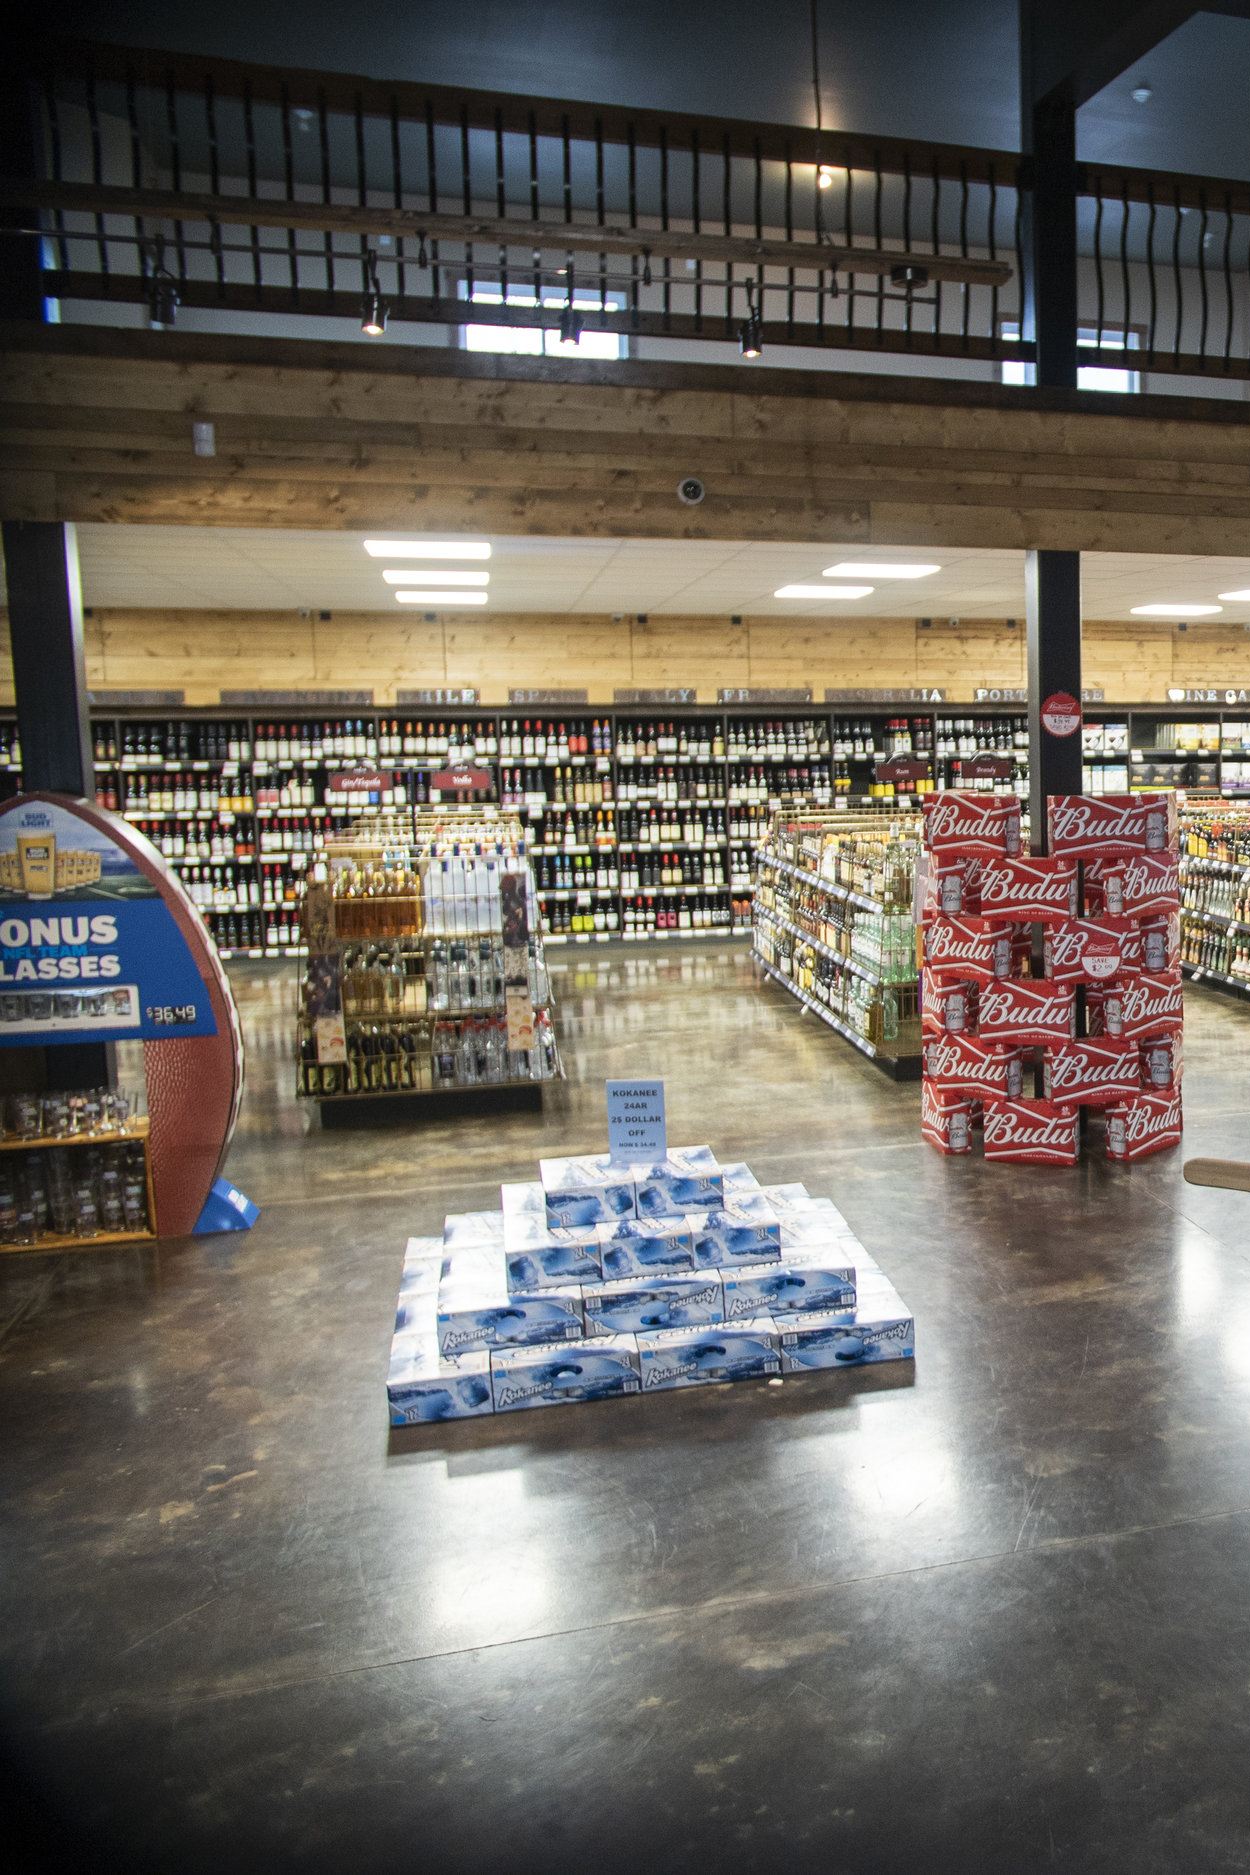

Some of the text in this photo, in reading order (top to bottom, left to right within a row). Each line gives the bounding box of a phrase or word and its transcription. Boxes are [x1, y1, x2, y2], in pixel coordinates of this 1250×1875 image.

[976, 689, 1027, 703] PORT
[21, 819, 51, 828] LIGHT
[3, 944, 88, 959] NFL TEAM
[612, 1089, 658, 1097] KOKANEE
[624, 1102, 648, 1110] 24AR
[628, 1129, 646, 1137] OFF
[729, 1293, 778, 1317] Kokanee
[442, 1325, 496, 1351] Kokanee
[644, 1361, 697, 1388] Kokanee
[498, 1382, 554, 1408] Kokanee
